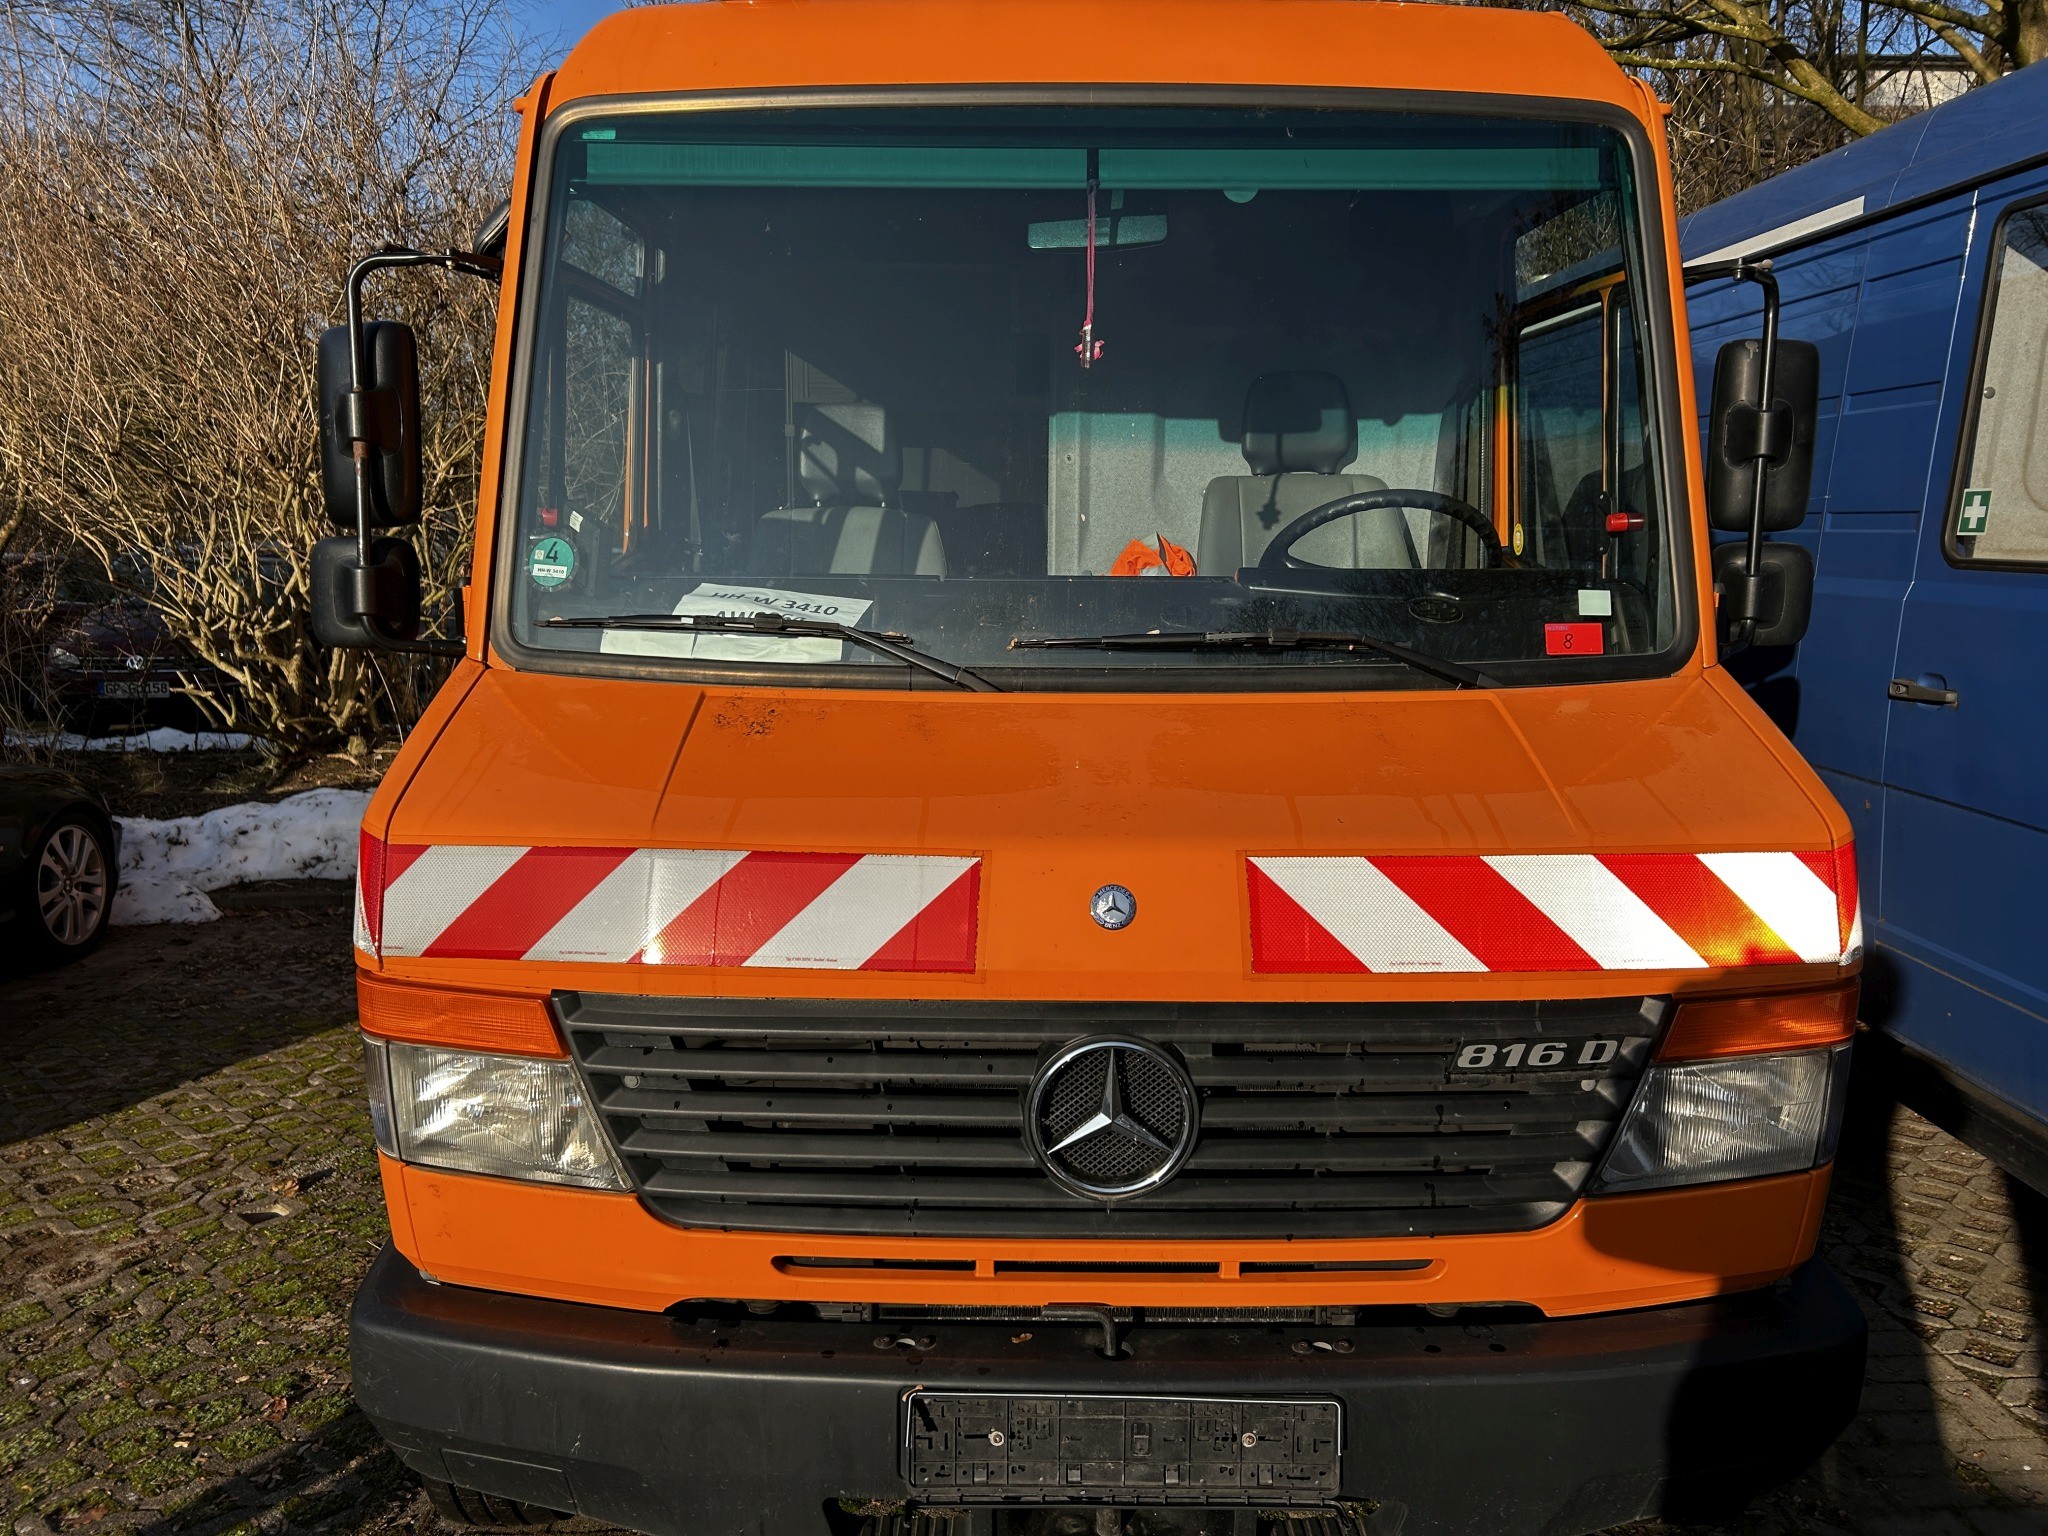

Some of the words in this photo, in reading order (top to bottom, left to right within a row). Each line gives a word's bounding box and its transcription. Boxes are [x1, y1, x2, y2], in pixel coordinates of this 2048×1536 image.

[546, 541, 559, 563] 4
[709, 592, 779, 605] HH-W
[781, 600, 839, 616] 3410
[1563, 633, 1573, 649] 8
[145, 682, 168, 694] 158
[1457, 1042, 1568, 1068] 816
[1577, 1040, 1618, 1065] D
